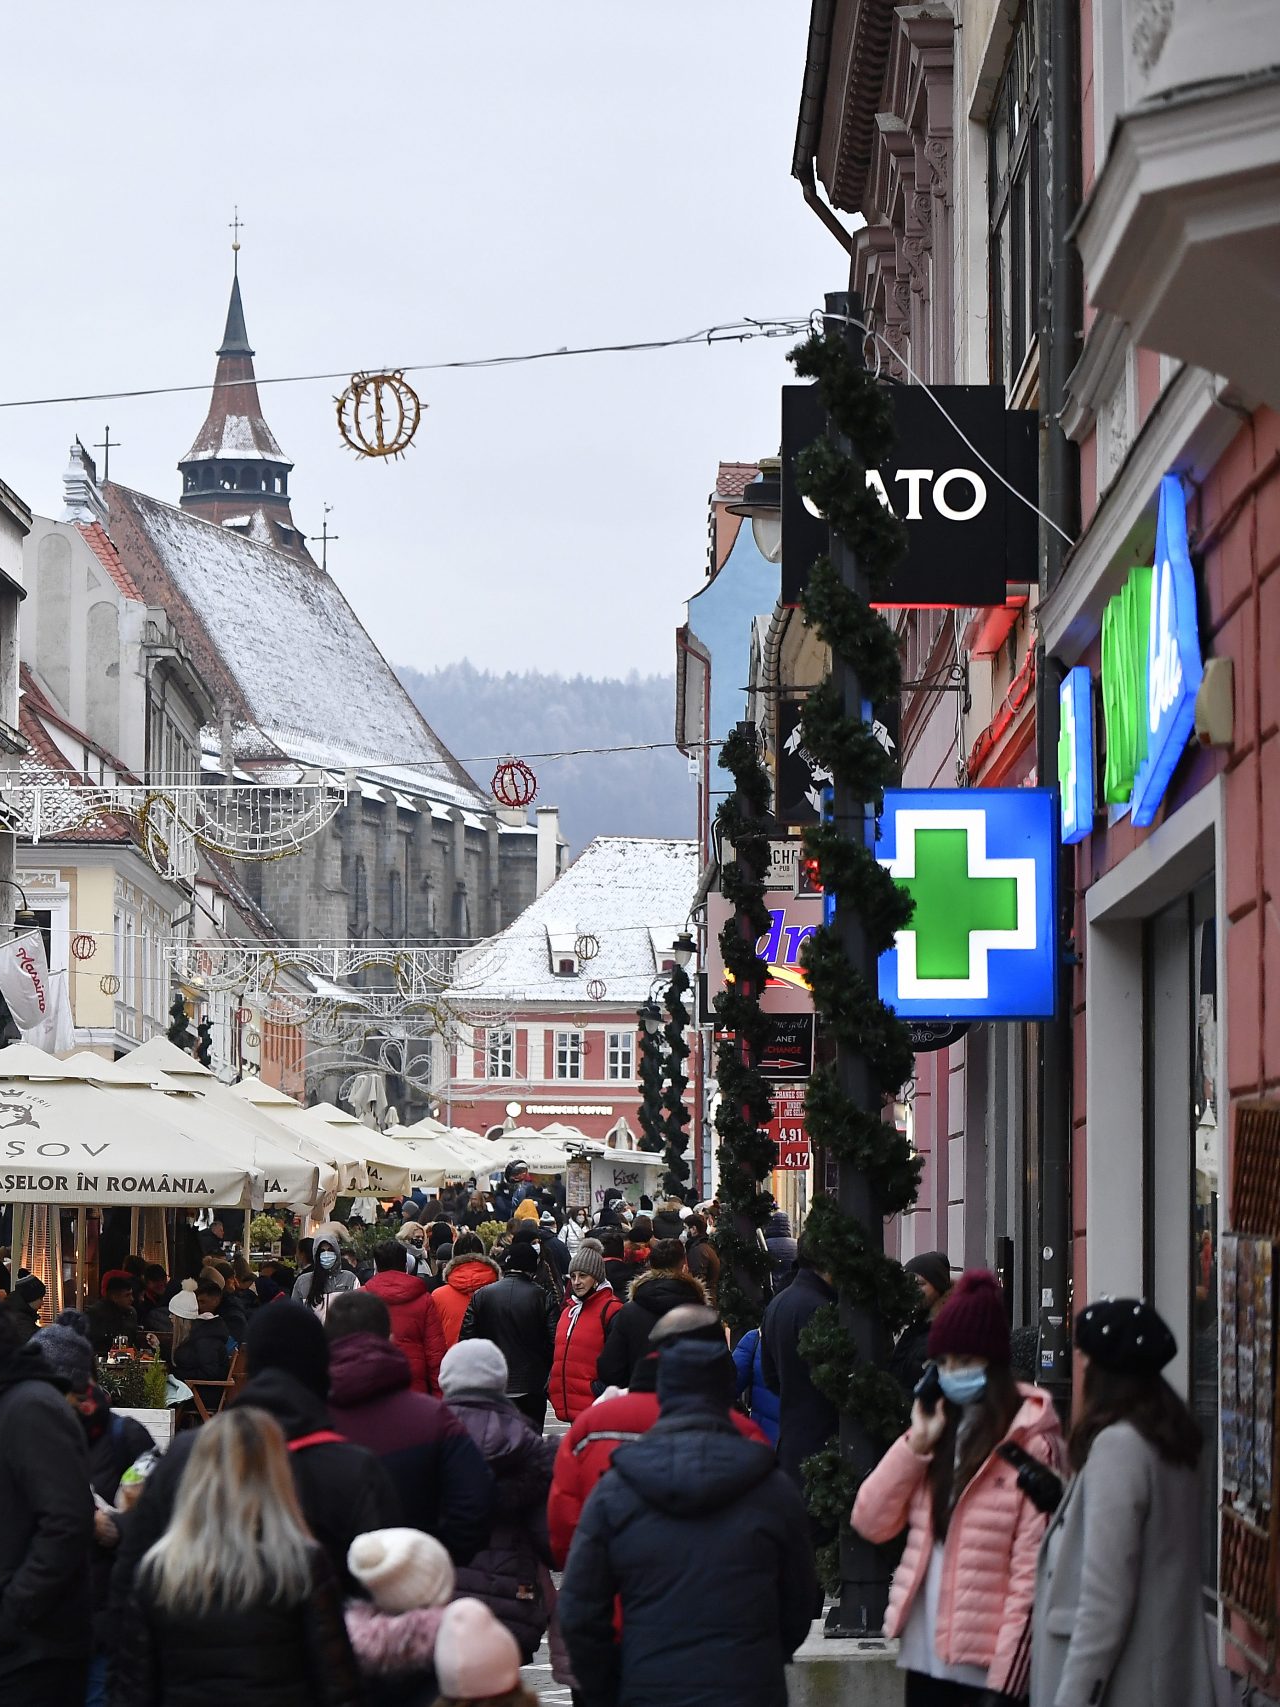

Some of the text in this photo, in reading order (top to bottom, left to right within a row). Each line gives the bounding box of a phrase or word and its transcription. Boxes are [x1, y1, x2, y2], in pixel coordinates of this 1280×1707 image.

[801, 468, 987, 521] ATO
[16, 947, 46, 1014] Massimo
[775, 1035, 797, 1043] ANET
[766, 1045, 802, 1054] CHANGE
[780, 1128, 802, 1146] 4,91
[785, 1152, 809, 1168] 4,17
[76, 1172, 99, 1191] ÎN
[106, 1173, 215, 1195] ROMÂNIA.
